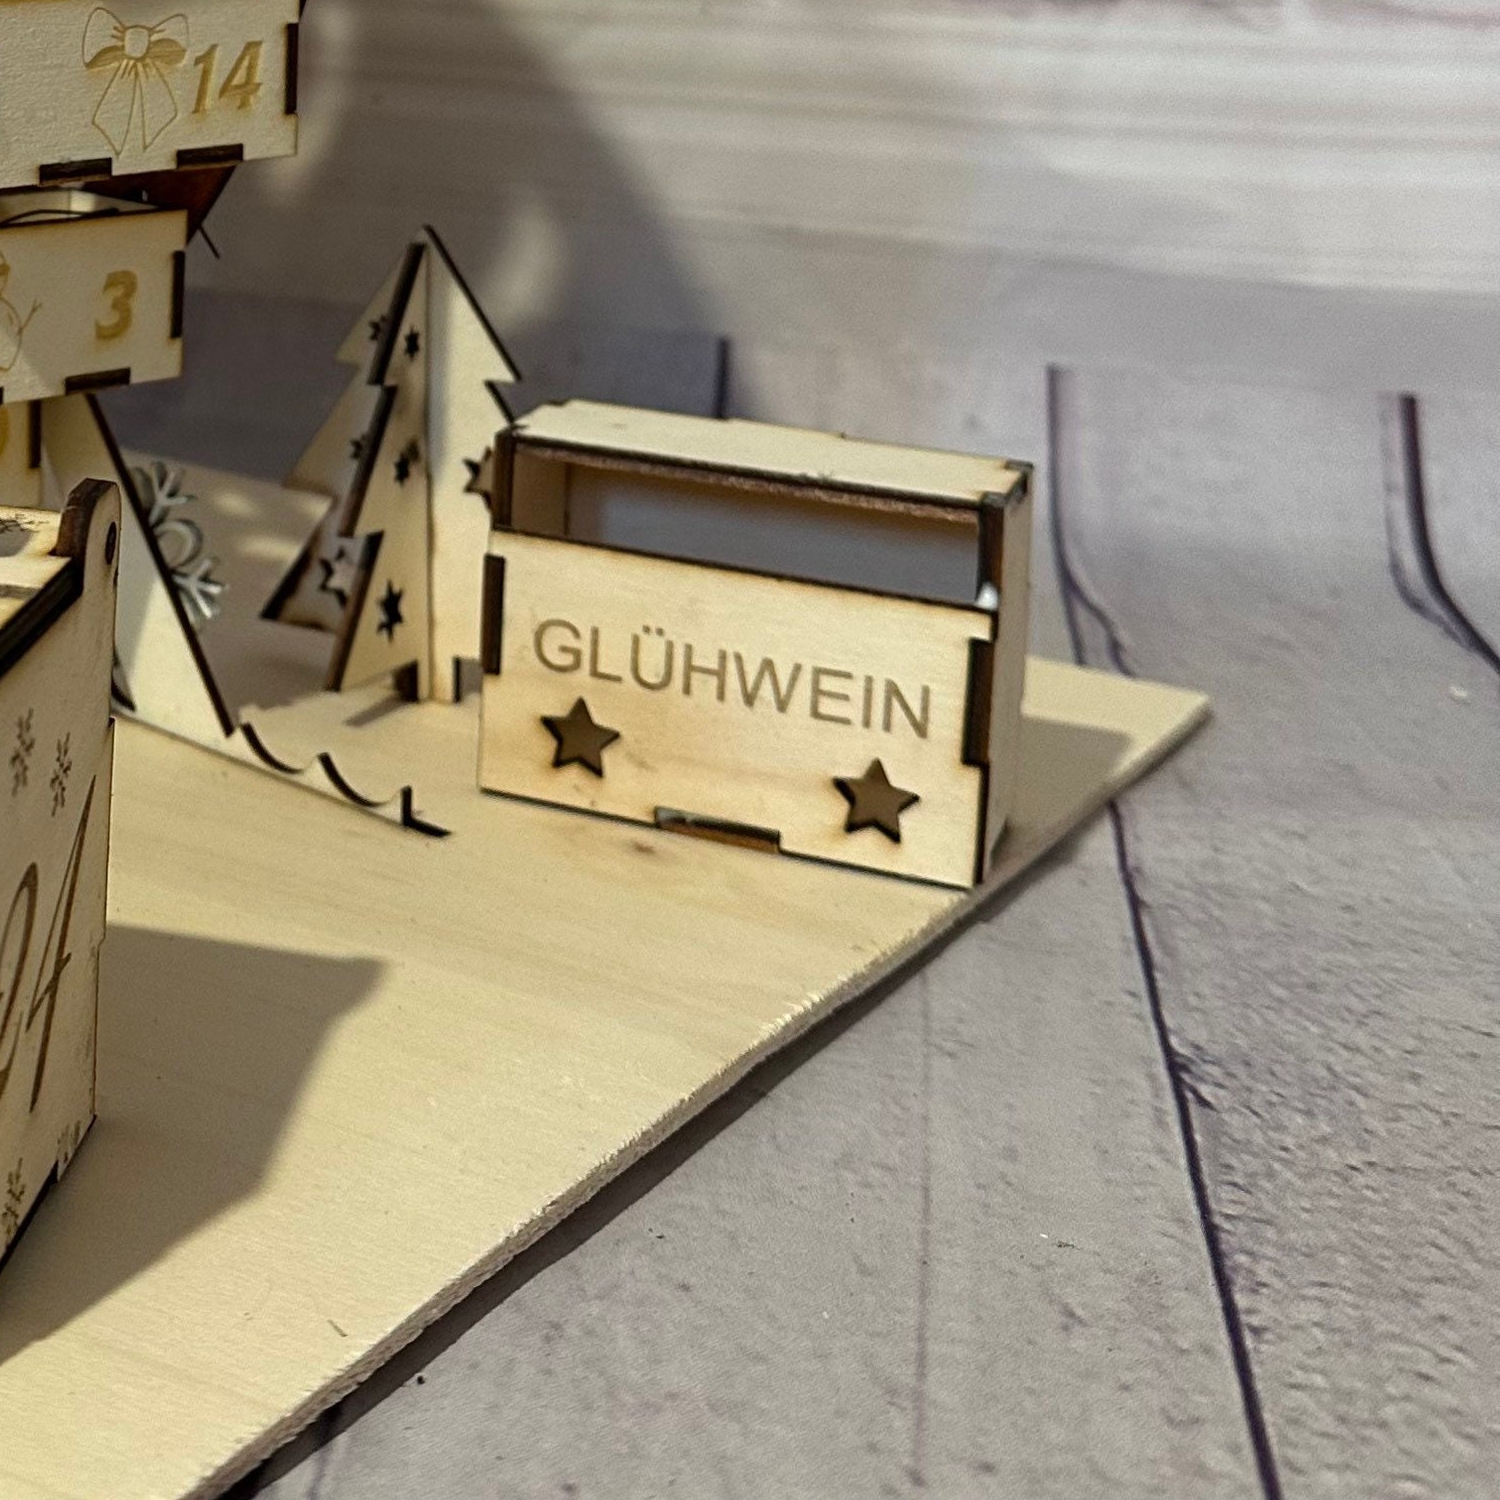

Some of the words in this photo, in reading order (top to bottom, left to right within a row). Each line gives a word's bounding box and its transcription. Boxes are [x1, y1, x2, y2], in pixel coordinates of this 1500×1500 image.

[193, 39, 264, 115] 14
[95, 269, 138, 341] 3
[532, 618, 931, 740] GLÜHWEIN
